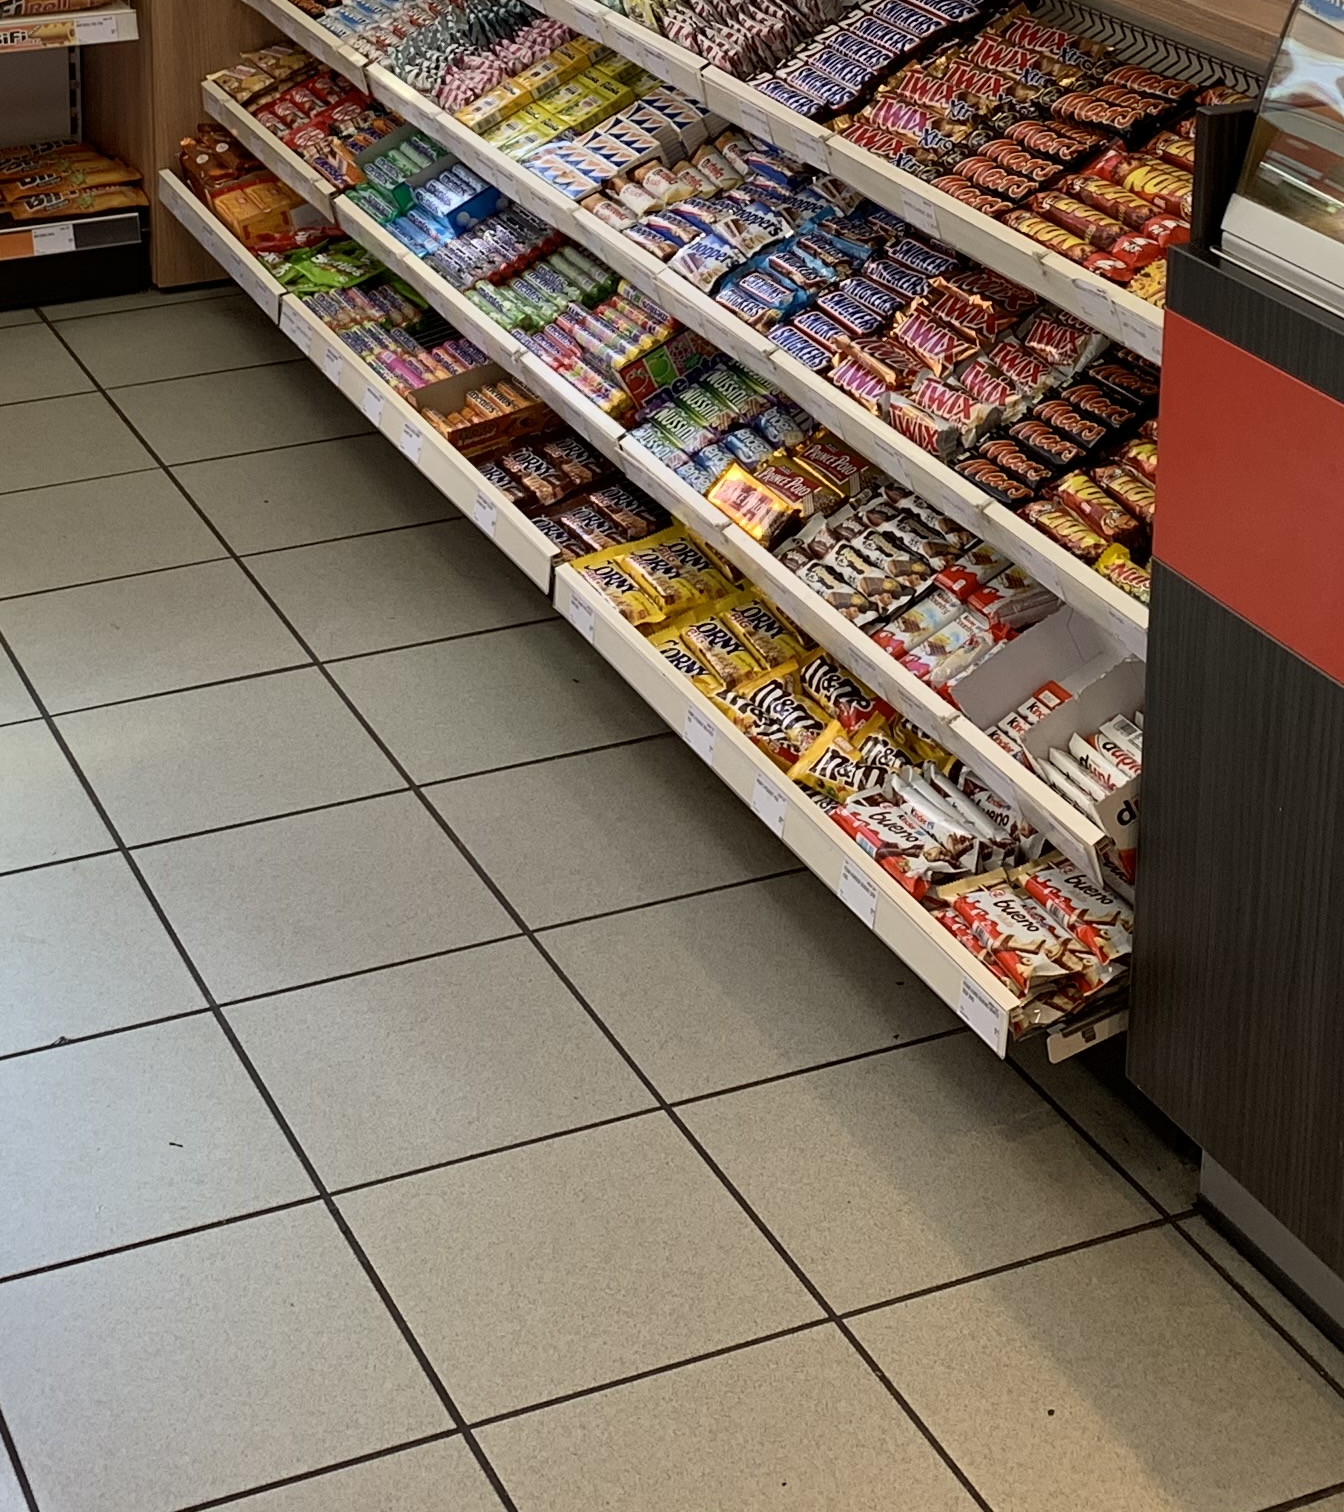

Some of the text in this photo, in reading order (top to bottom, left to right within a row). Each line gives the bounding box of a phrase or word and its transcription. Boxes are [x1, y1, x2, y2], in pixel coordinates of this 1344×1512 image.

[876, 0, 942, 36] SNICKERS
[1008, 16, 1074, 52] TWIX
[828, 32, 892, 68] SNICKERS
[946, 60, 1014, 98] TWIX
[872, 96, 937, 133] TWIX
[869, 812, 918, 842] bueno
[1065, 874, 1114, 904] bueno
[994, 900, 1039, 932] bueno
